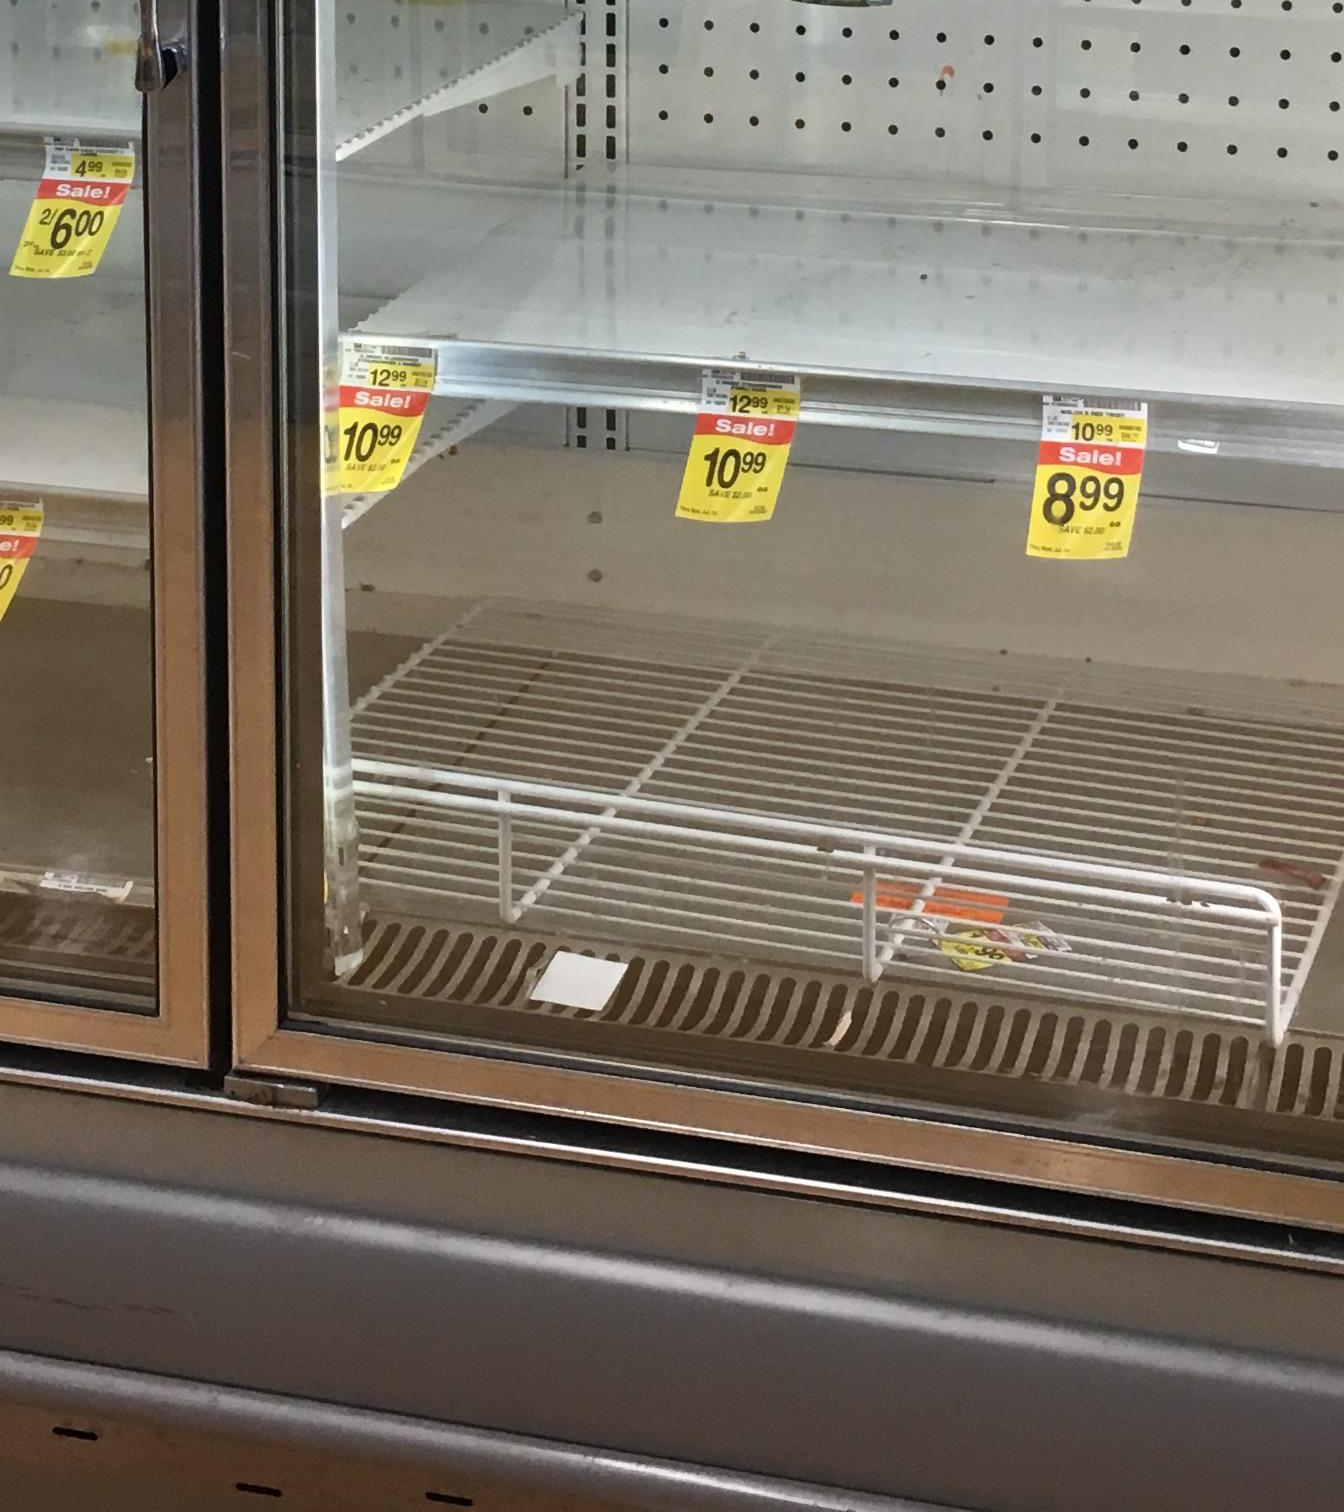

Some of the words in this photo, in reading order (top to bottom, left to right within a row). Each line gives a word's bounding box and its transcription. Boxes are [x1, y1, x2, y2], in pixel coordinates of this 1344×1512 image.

[74, 160, 103, 177] 499
[56, 183, 110, 199] Sale!
[38, 207, 104, 250] 2/600
[370, 369, 406, 386] 1299
[354, 392, 409, 408] Sale!
[730, 394, 768, 413] 1299
[715, 418, 775, 437] Sale!
[1072, 421, 1113, 441] 1099
[343, 421, 402, 463] 1099
[1058, 446, 1122, 466] Sale!
[704, 447, 767, 489] 1099
[1042, 472, 1125, 526] 899
